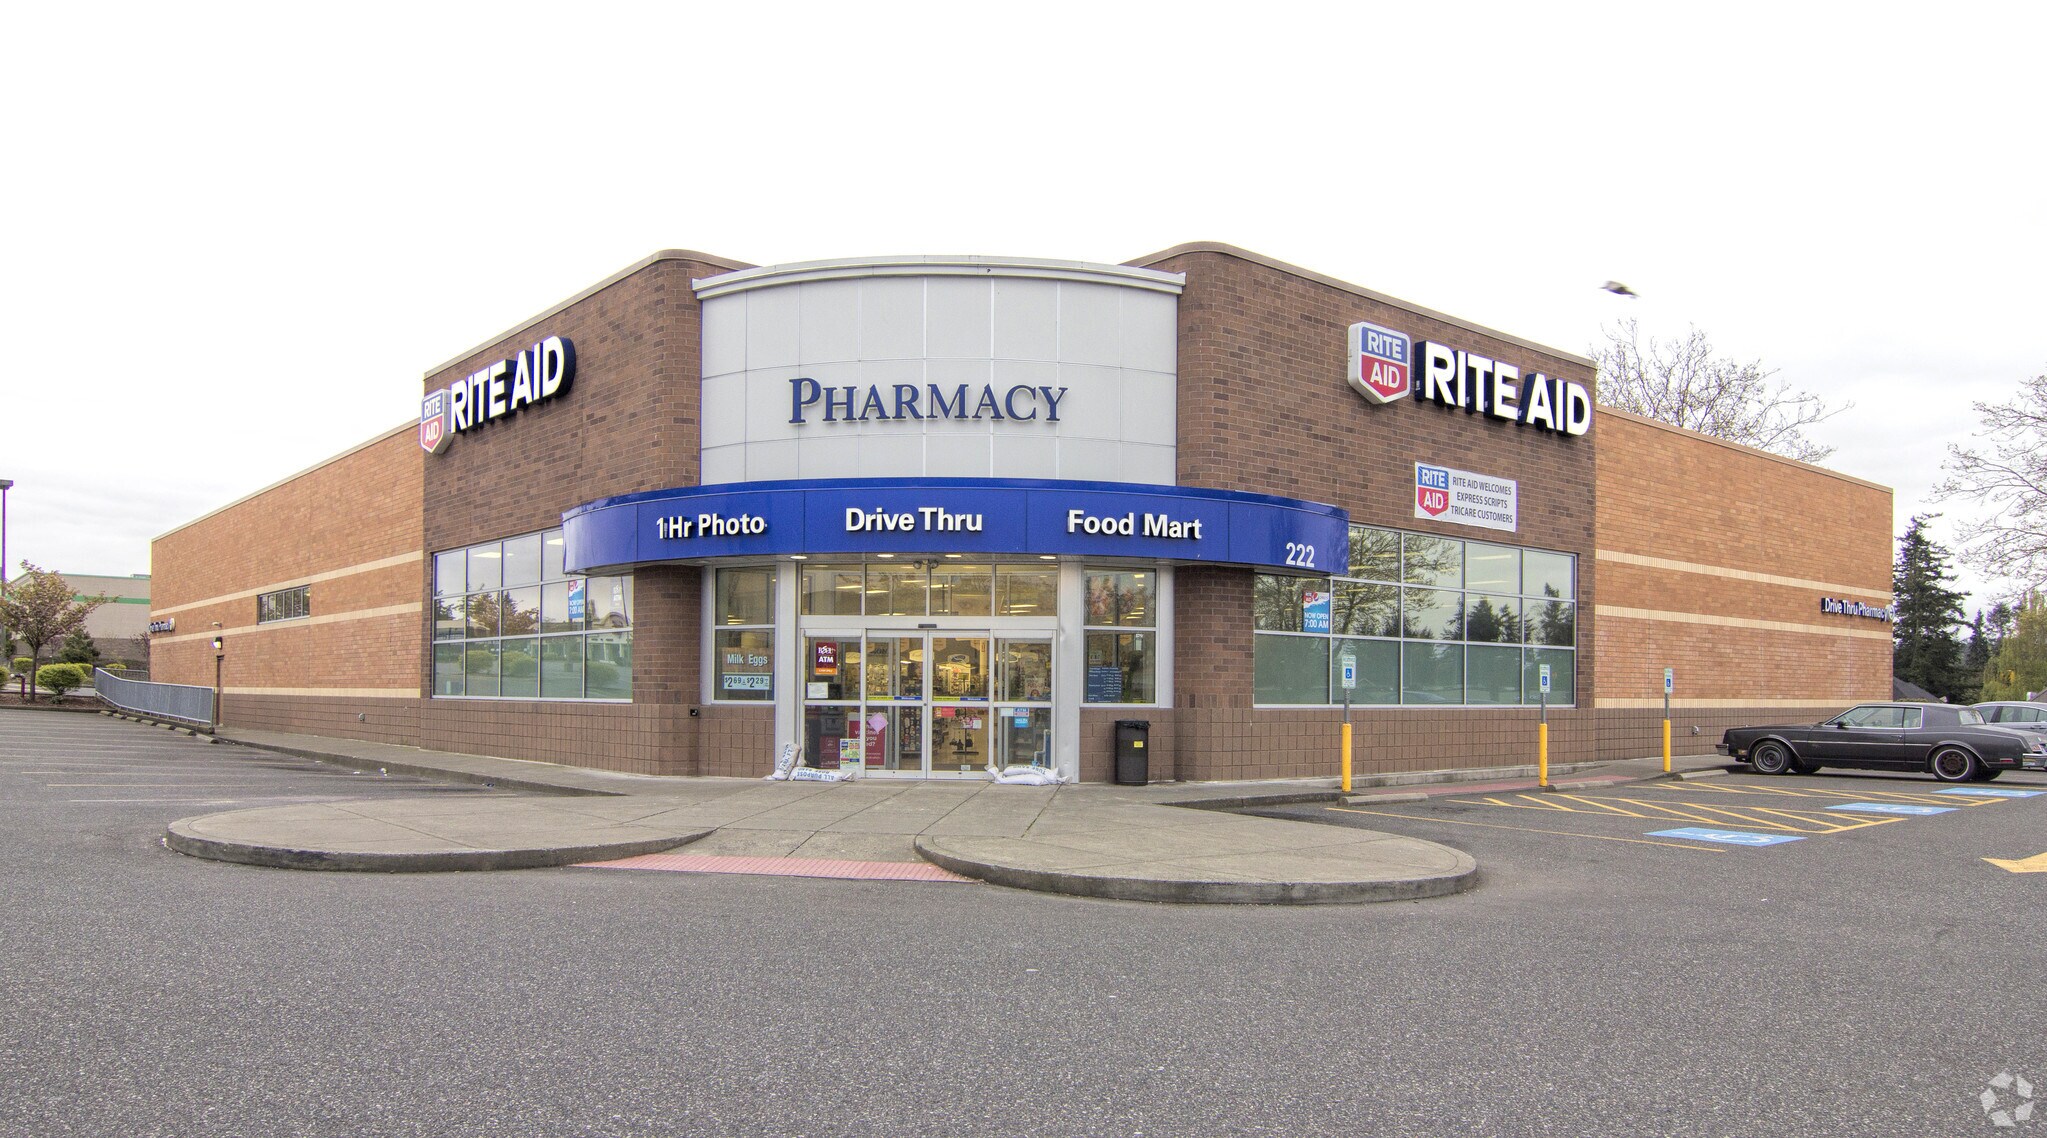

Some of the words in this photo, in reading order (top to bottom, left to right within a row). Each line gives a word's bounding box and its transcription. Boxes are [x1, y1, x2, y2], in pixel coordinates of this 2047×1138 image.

[1368, 331, 1402, 359] RITE
[450, 359, 506, 433] RITE
[511, 336, 565, 410] AID
[1370, 362, 1400, 388] AID
[788, 377, 1068, 423] PHARMACY
[1425, 341, 1519, 420] RITE
[1526, 373, 1592, 436] AID
[424, 395, 441, 419] RITE
[425, 421, 439, 443] AID
[1421, 469, 1446, 487] RITE
[1452, 476, 1466, 487] RITE
[1467, 479, 1478, 490] AID
[1479, 481, 1512, 496] WELCOMES
[1424, 491, 1444, 509] AID
[1456, 491, 1483, 505] EXPRESS
[1484, 496, 1508, 509] SCRIPTS
[698, 513, 765, 536] Photo
[845, 507, 914, 532] Drive
[918, 507, 983, 532] Thru
[1068, 509, 1134, 535] Food
[1143, 512, 1202, 539] Mart
[1450, 505, 1476, 518] TRICARE
[1477, 509, 1513, 524] CUSTOMERS
[1285, 542, 1315, 568] 222
[1825, 597, 1842, 613] Drive
[1842, 600, 1857, 615] Thru
[1858, 602, 1887, 621] Pharmacy
[1304, 619, 1317, 627] 7:00
[1318, 620, 1329, 628] AM
[727, 654, 744, 664] Milk
[748, 654, 768, 667] Eggs
